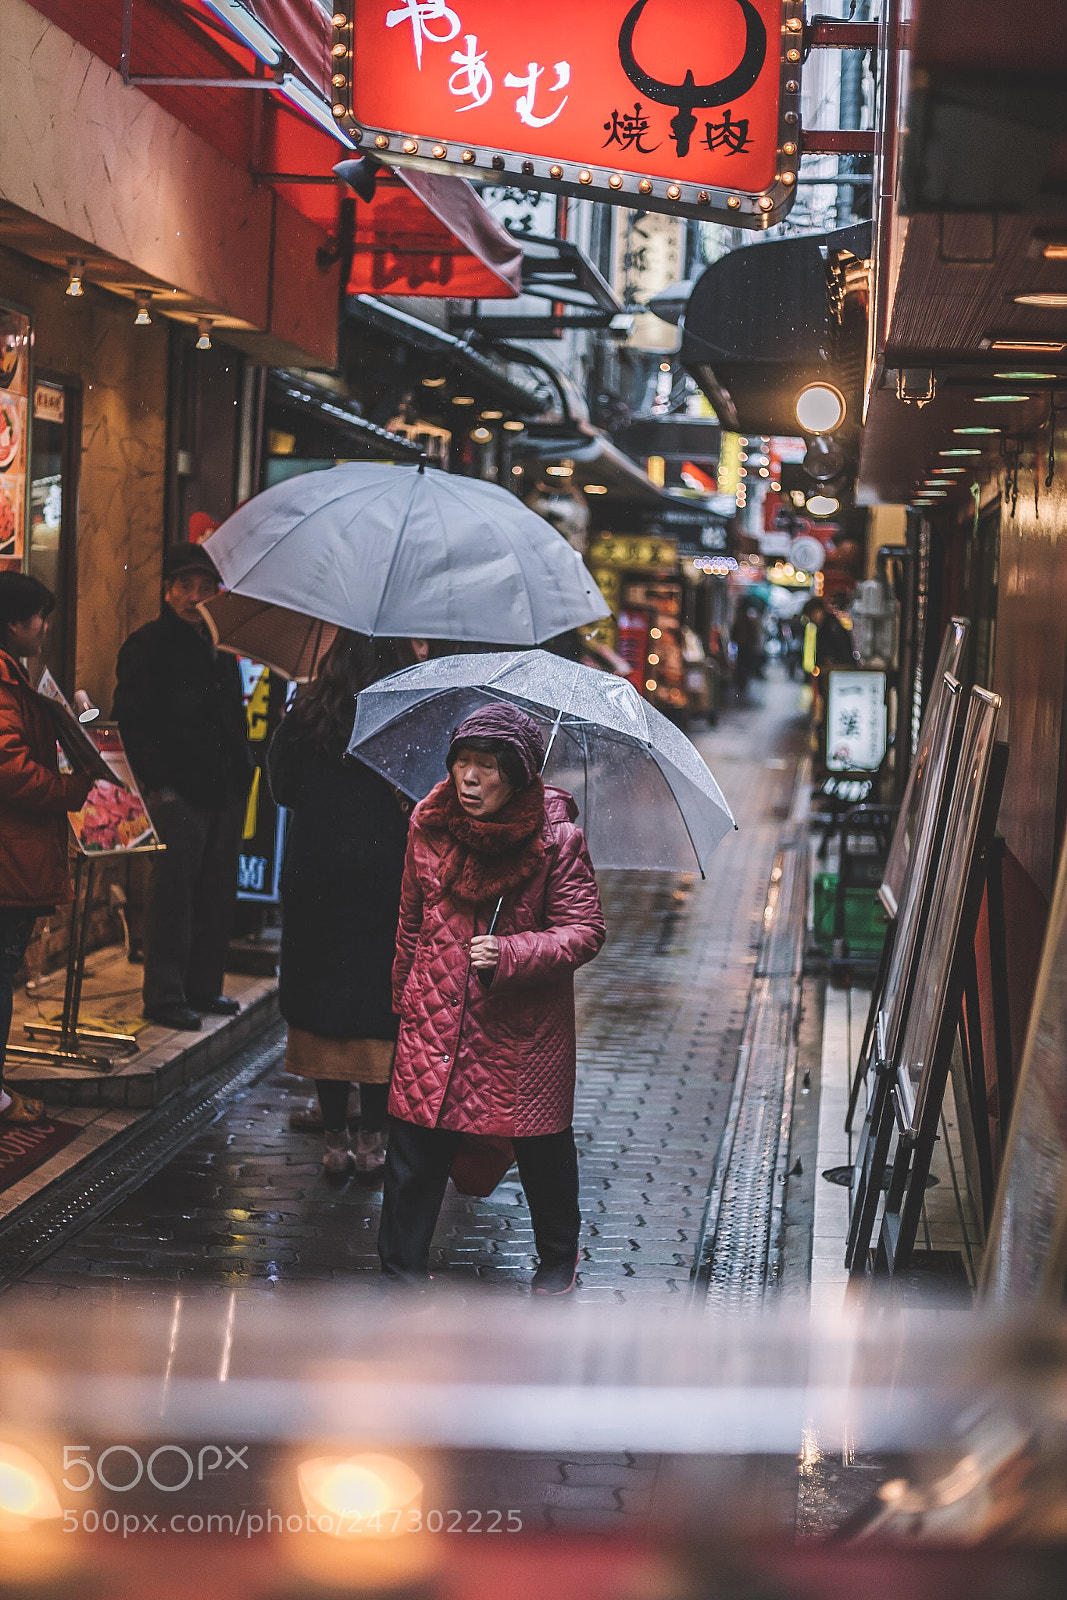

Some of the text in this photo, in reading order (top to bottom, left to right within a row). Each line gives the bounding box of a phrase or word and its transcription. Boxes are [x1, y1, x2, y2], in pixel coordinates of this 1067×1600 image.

[386, 0, 571, 128] やあむ
[602, 103, 755, 157] 焼肉
